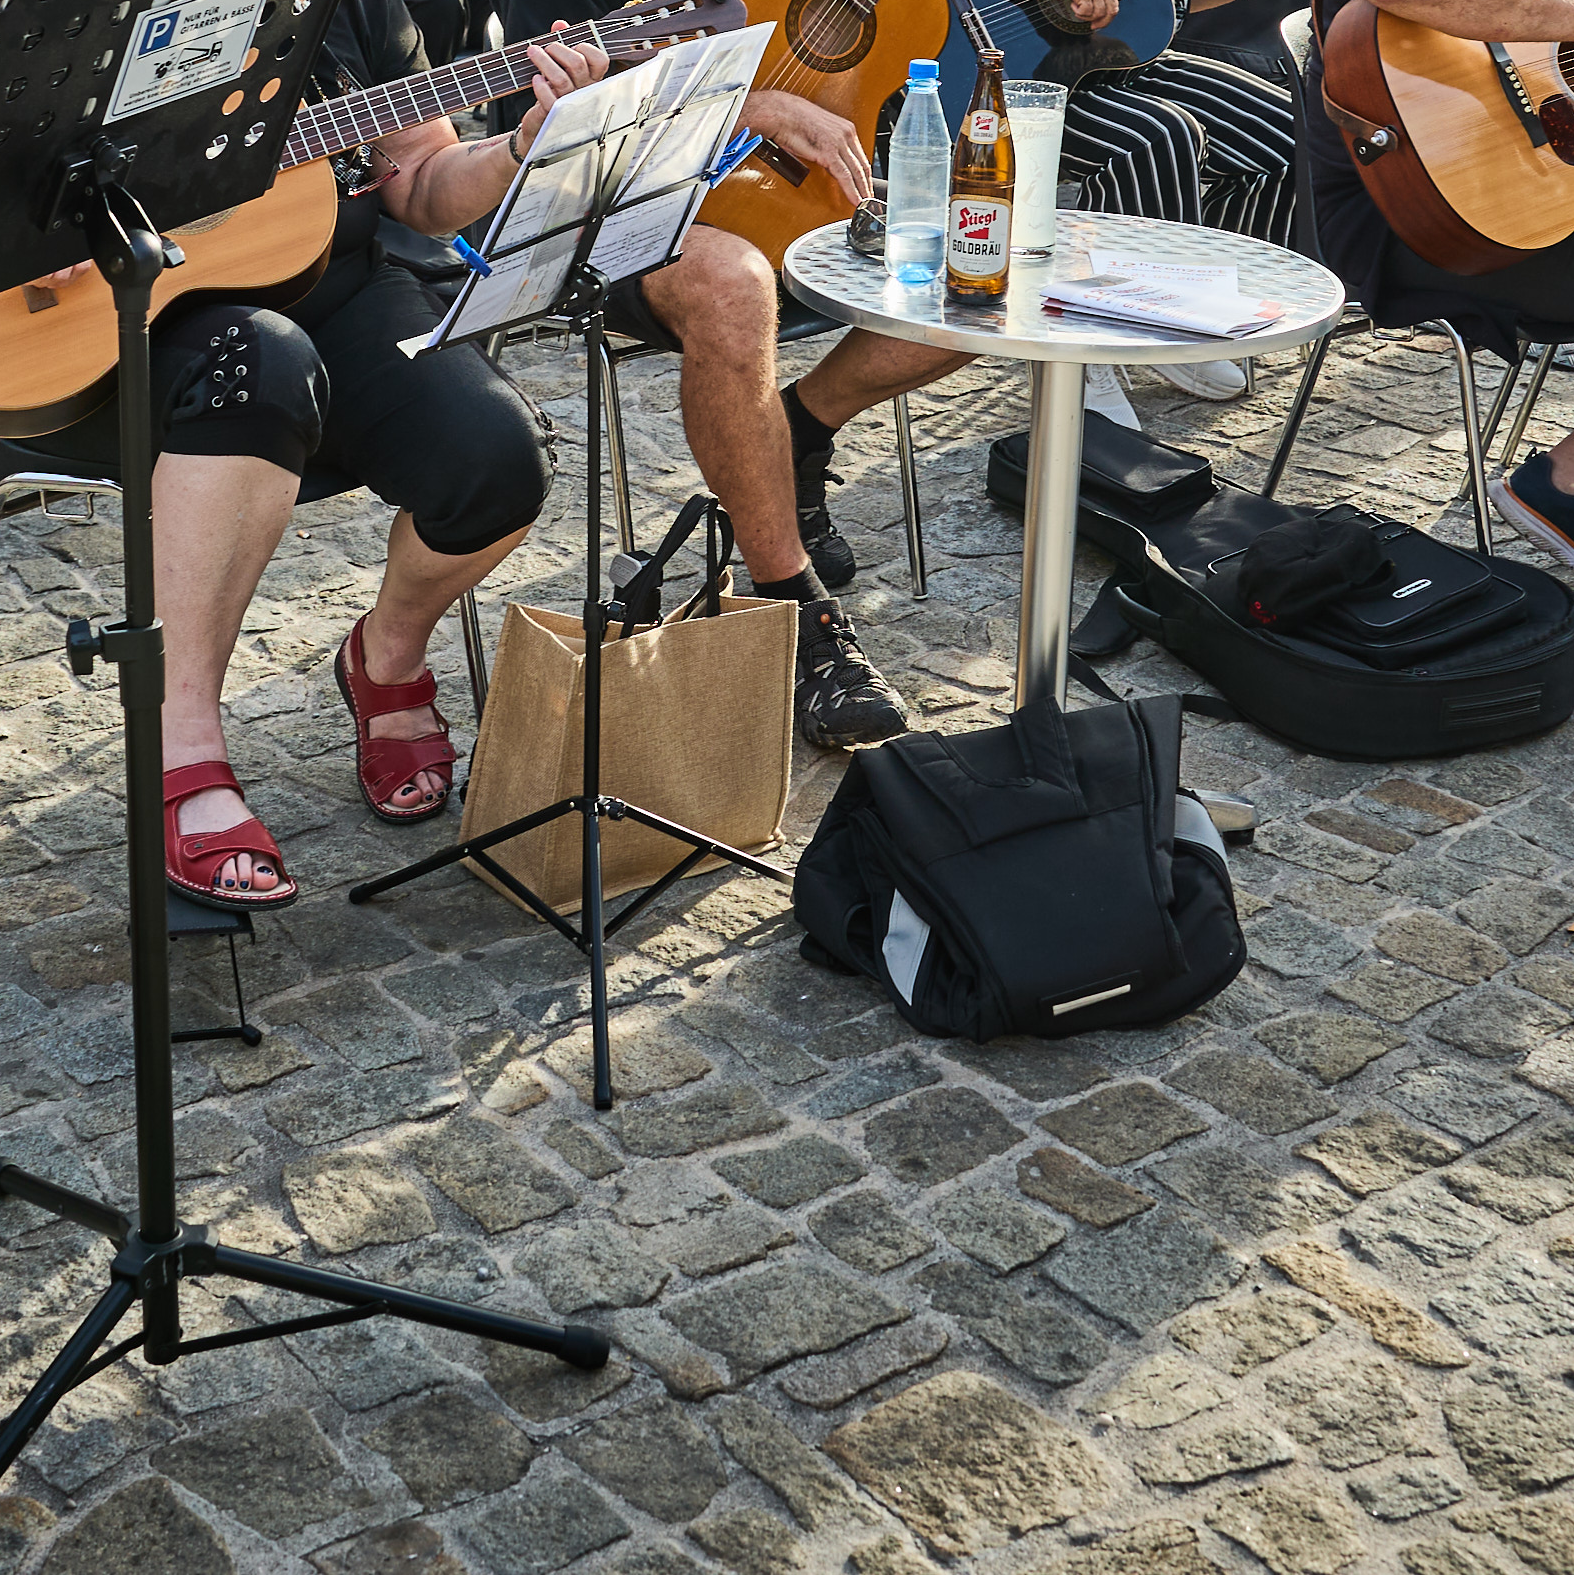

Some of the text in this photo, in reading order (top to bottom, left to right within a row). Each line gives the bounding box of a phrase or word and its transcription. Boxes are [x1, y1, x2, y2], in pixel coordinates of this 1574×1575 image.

[180, 3, 257, 35] GITARREN & BÄSSE
[183, 5, 221, 25] NUR FÜR
[146, 17, 172, 50] P
[958, 206, 997, 230] Stiegl
[952, 240, 1002, 257] GOLDBRÄU
